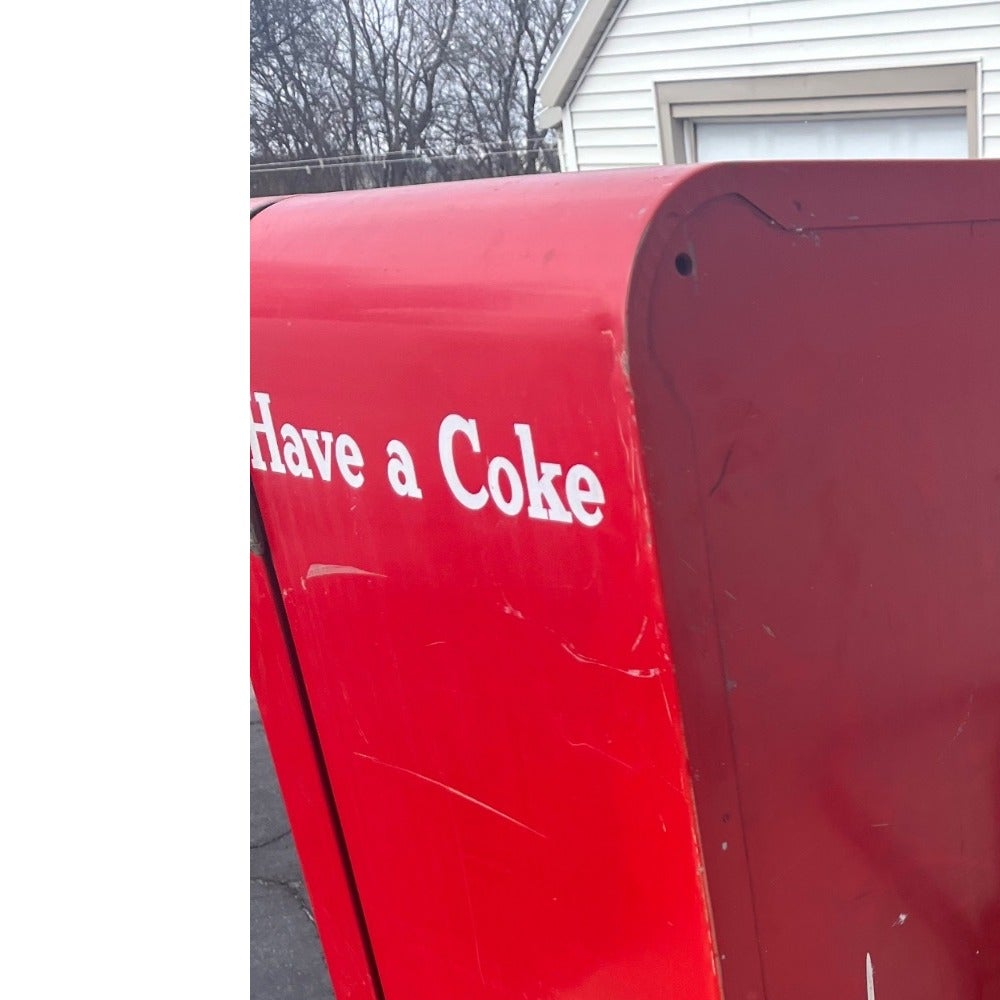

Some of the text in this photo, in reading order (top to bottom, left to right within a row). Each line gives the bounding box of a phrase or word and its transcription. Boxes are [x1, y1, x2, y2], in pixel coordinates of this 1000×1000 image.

[250, 391, 606, 527] Have a Coke
